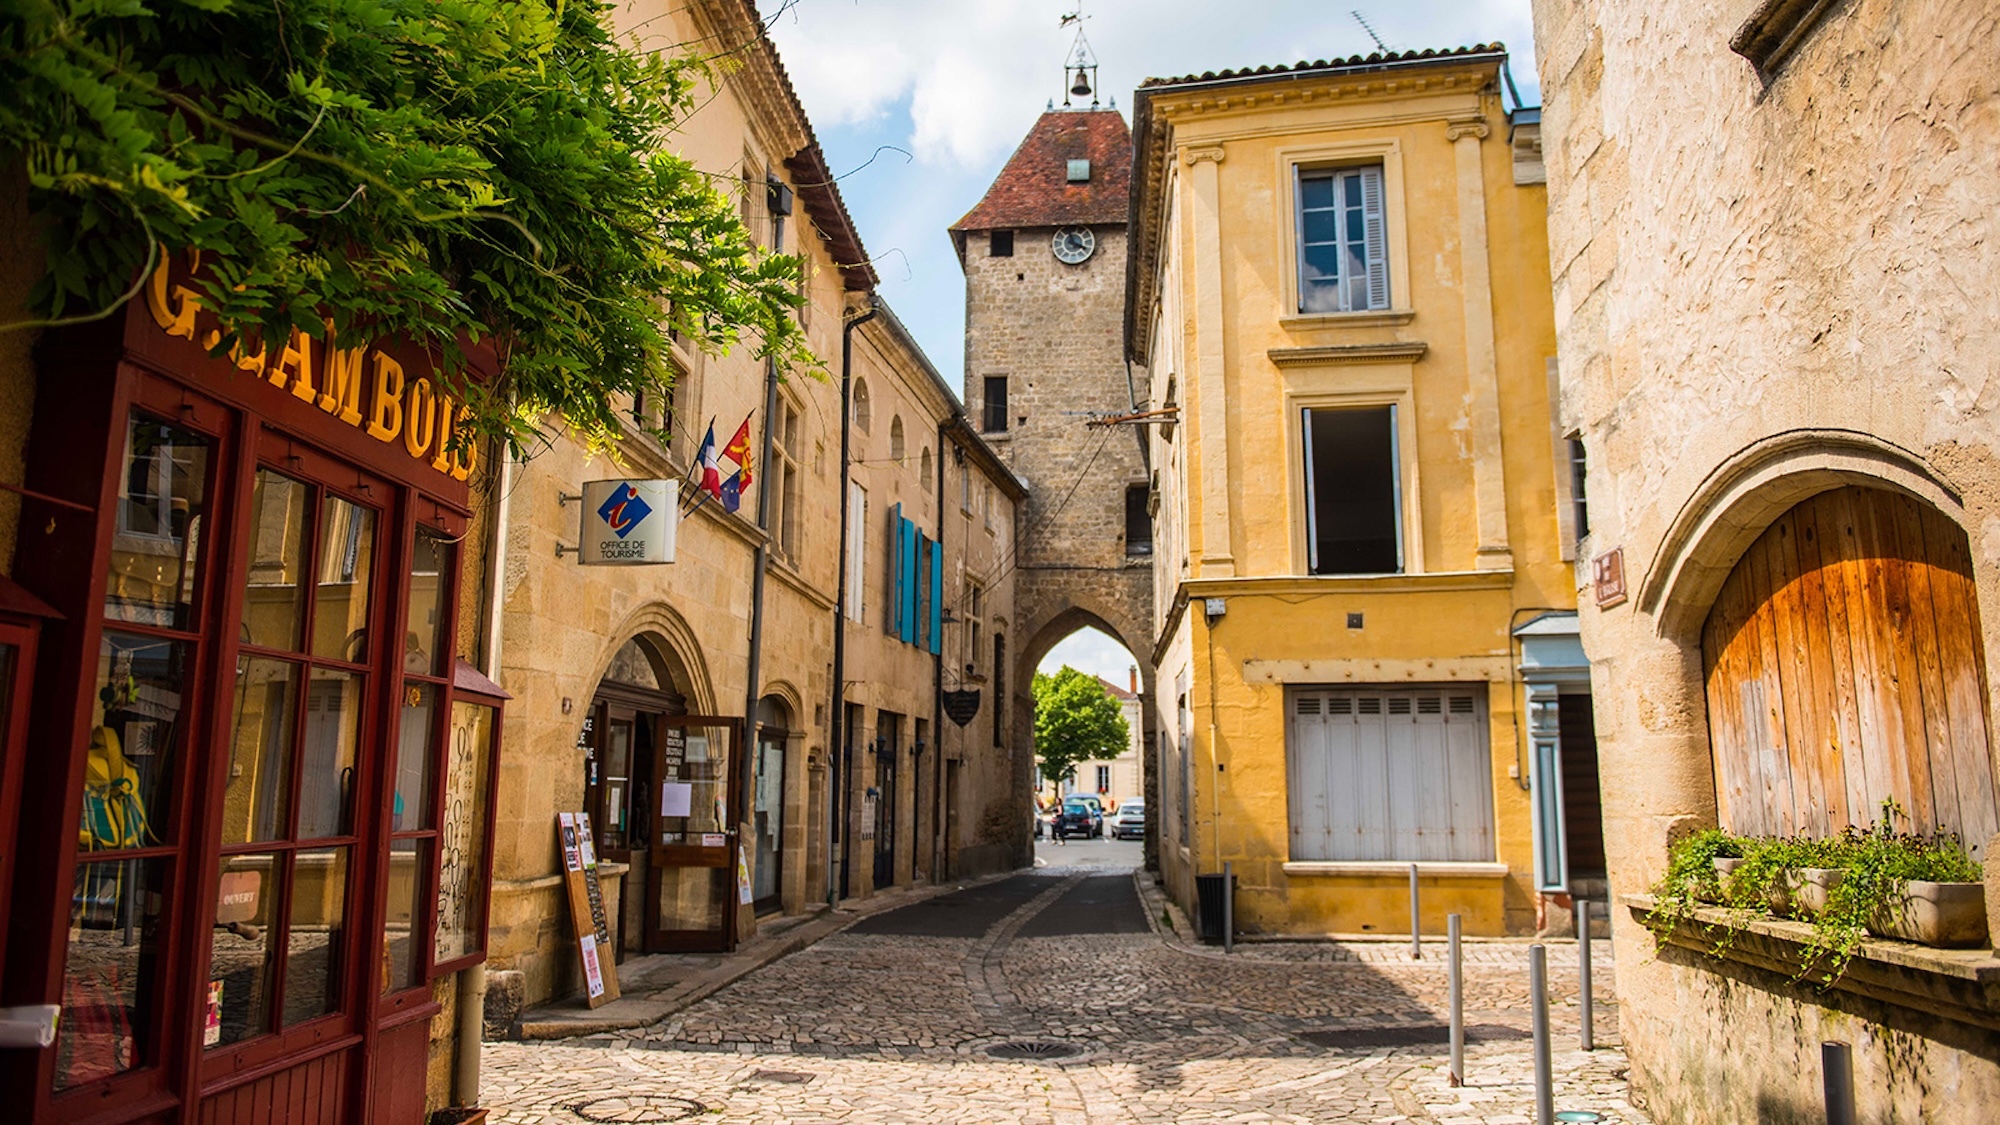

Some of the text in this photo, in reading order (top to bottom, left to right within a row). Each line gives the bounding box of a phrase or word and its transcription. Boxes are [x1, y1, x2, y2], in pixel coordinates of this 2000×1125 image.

[600, 541, 645, 550] OFFICE DE
[602, 550, 645, 558] TOURISME
[223, 892, 255, 905] OUVERT
